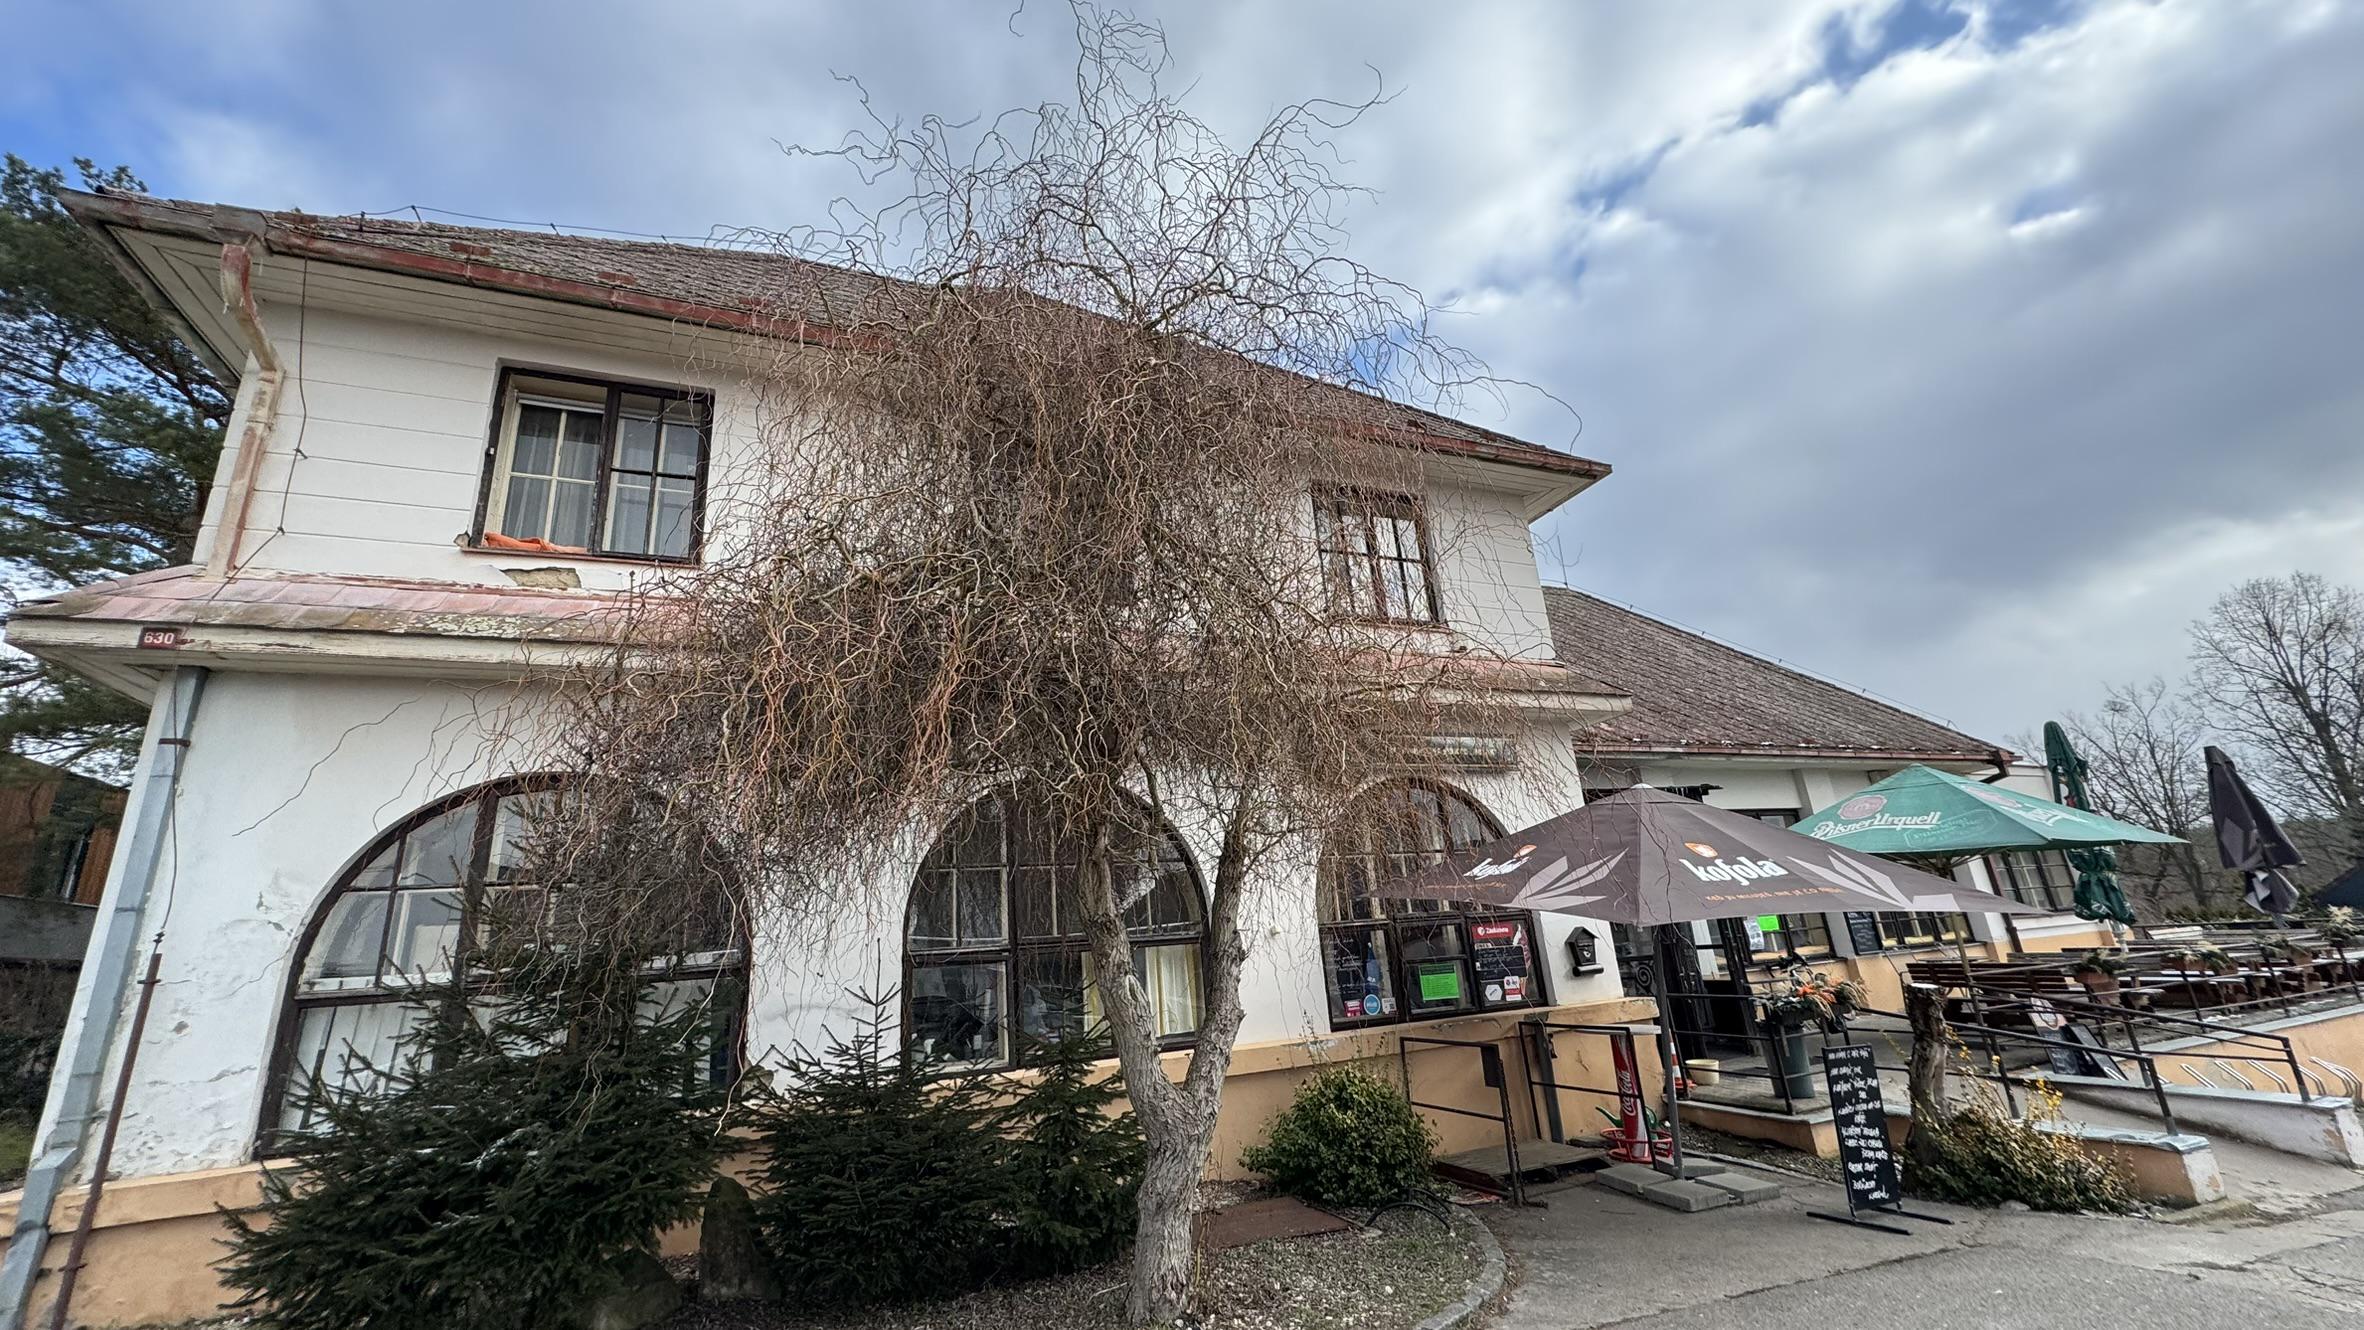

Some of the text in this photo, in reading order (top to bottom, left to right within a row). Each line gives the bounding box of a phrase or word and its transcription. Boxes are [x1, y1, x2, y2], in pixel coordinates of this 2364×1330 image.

[143, 631, 175, 645] 630
[1809, 811, 1941, 840] Pilsner Urquell
[1678, 856, 1789, 886] kofola
[1619, 1069, 1637, 1116] CocaCola
